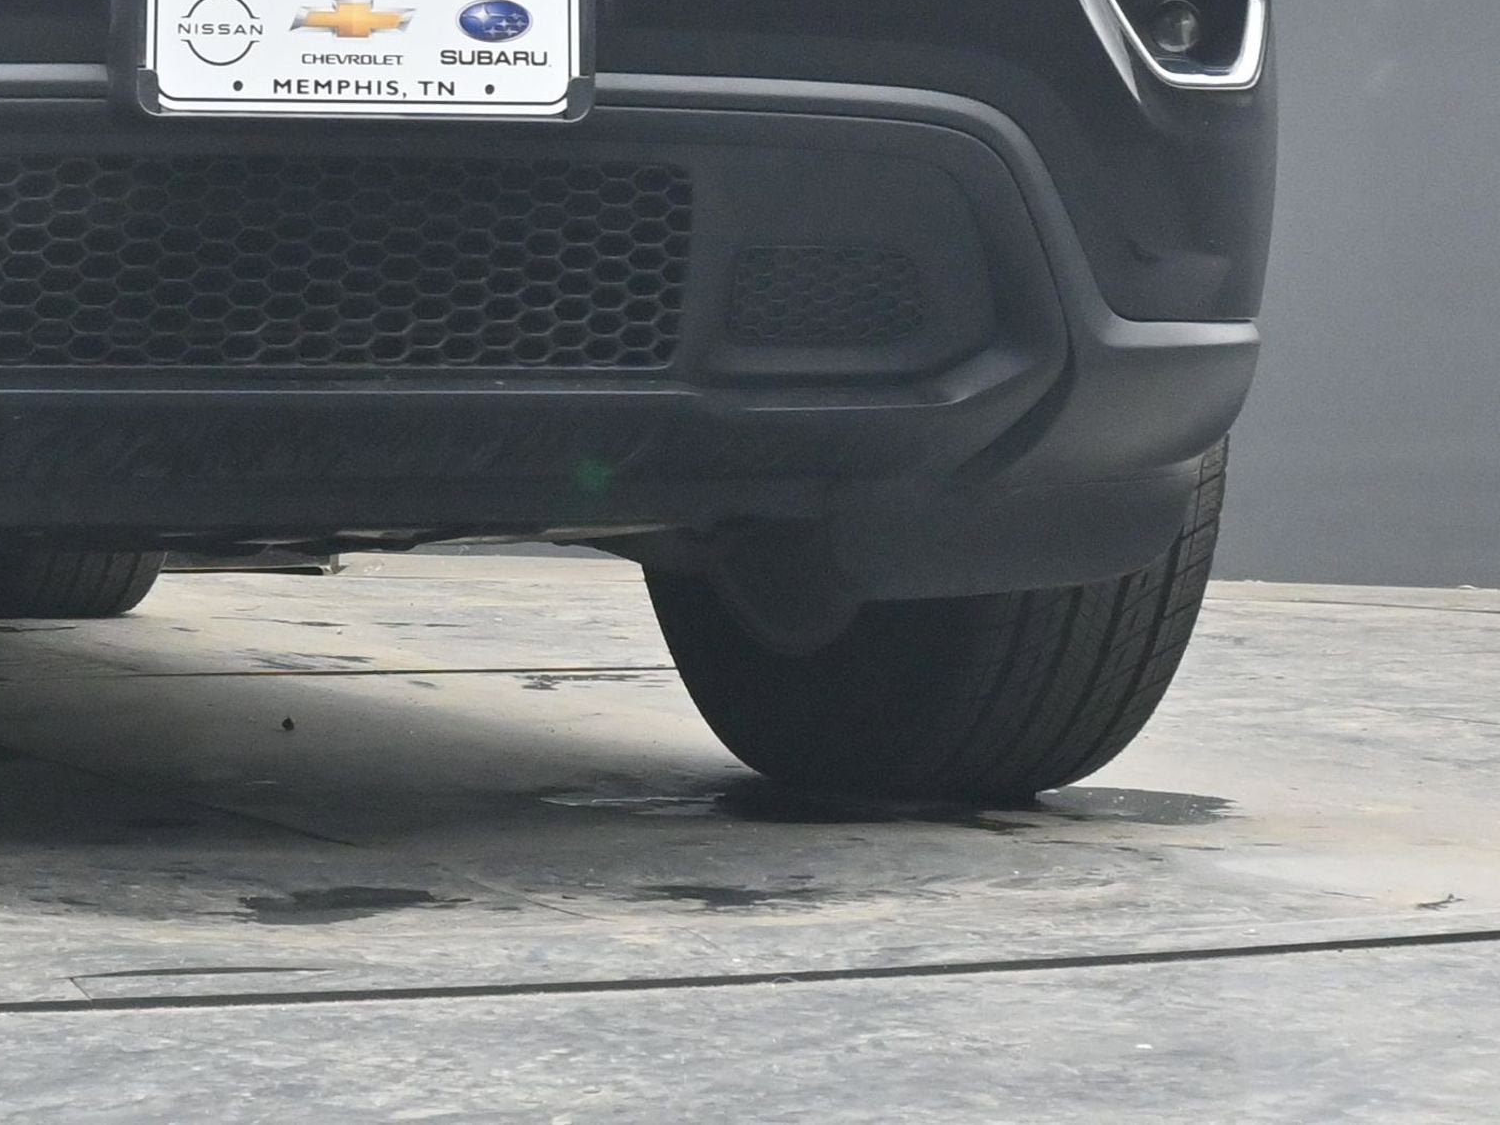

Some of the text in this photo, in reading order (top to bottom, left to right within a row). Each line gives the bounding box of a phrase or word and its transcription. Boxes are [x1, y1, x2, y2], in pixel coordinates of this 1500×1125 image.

[177, 23, 263, 36] NISSAN
[301, 53, 403, 66] CHEVROLET
[440, 49, 549, 67] SUBARU
[273, 78, 456, 98] MEMPHIS, TN
